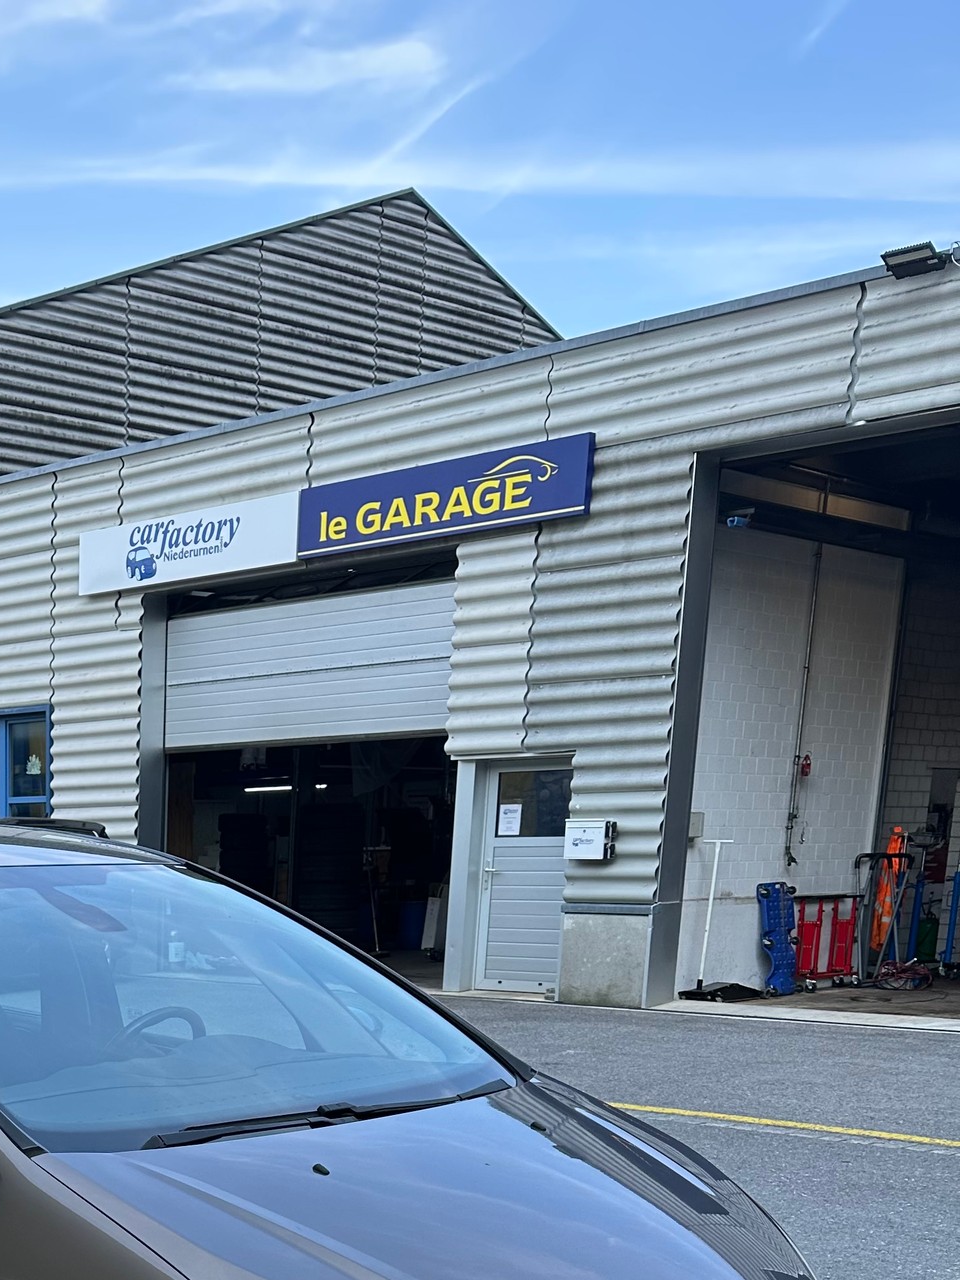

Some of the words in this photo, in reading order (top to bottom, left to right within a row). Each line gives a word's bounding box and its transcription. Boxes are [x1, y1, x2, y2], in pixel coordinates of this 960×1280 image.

[319, 511, 348, 542] le
[355, 473, 533, 535] GARAGE
[129, 516, 241, 560] carfactory
[163, 543, 220, 562] Niederurnen
